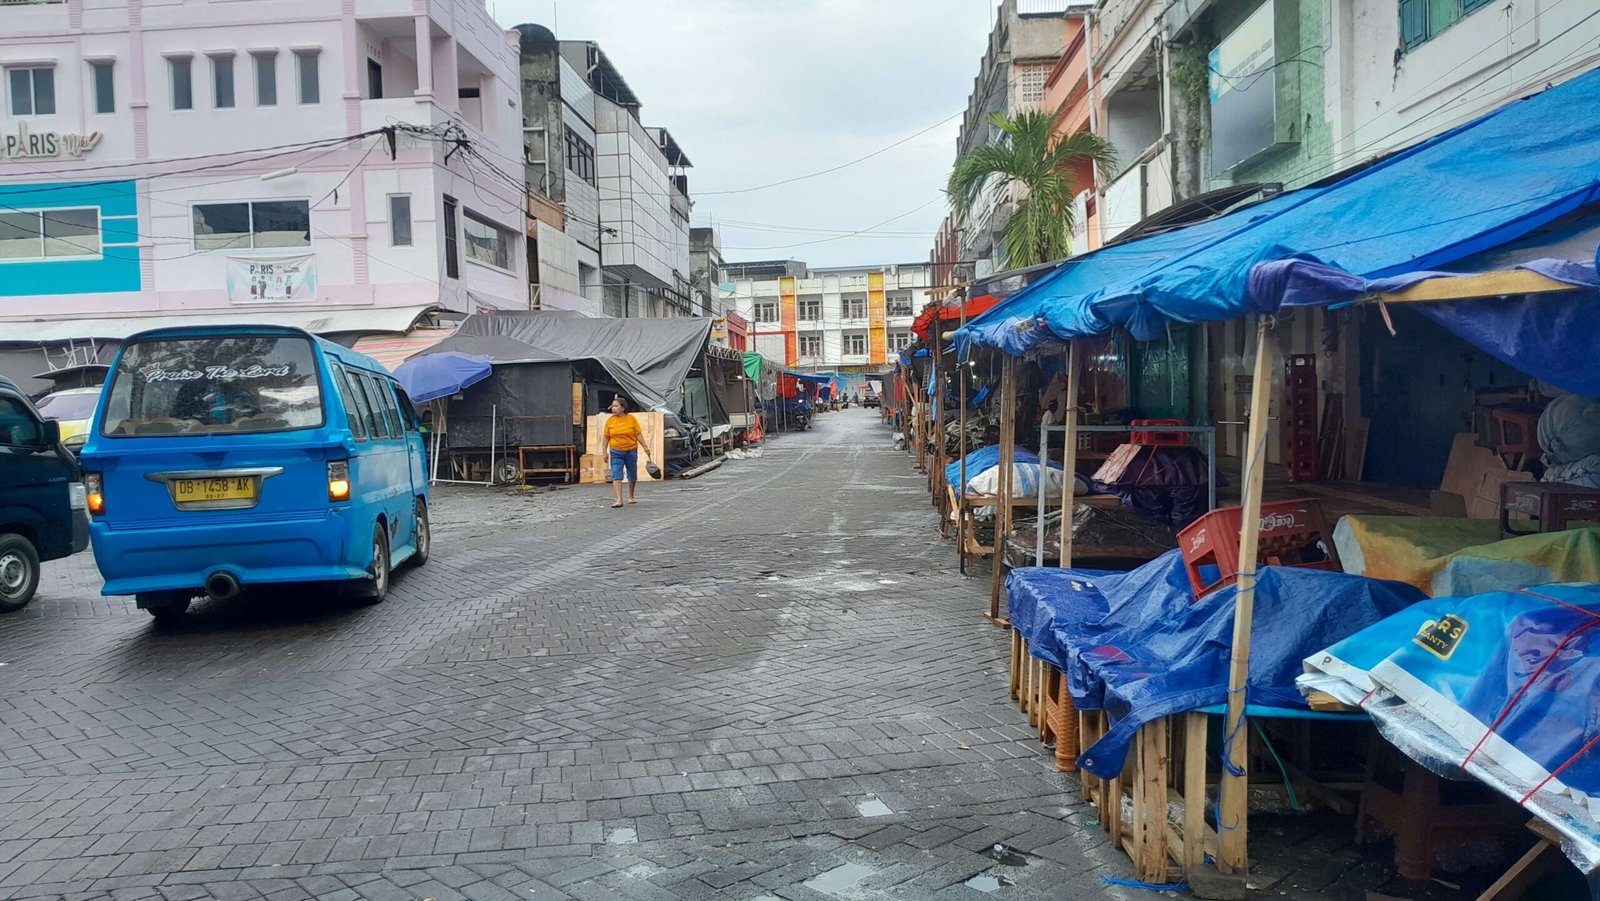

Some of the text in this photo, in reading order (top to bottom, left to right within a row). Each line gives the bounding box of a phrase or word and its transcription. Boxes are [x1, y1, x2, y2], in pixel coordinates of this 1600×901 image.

[7, 123, 56, 156] PARIS
[250, 263, 274, 275] PARIS
[145, 364, 290, 383] Praise The Lord
[179, 478, 249, 494] DB 1458 AK
[1437, 619, 1462, 639] RS
